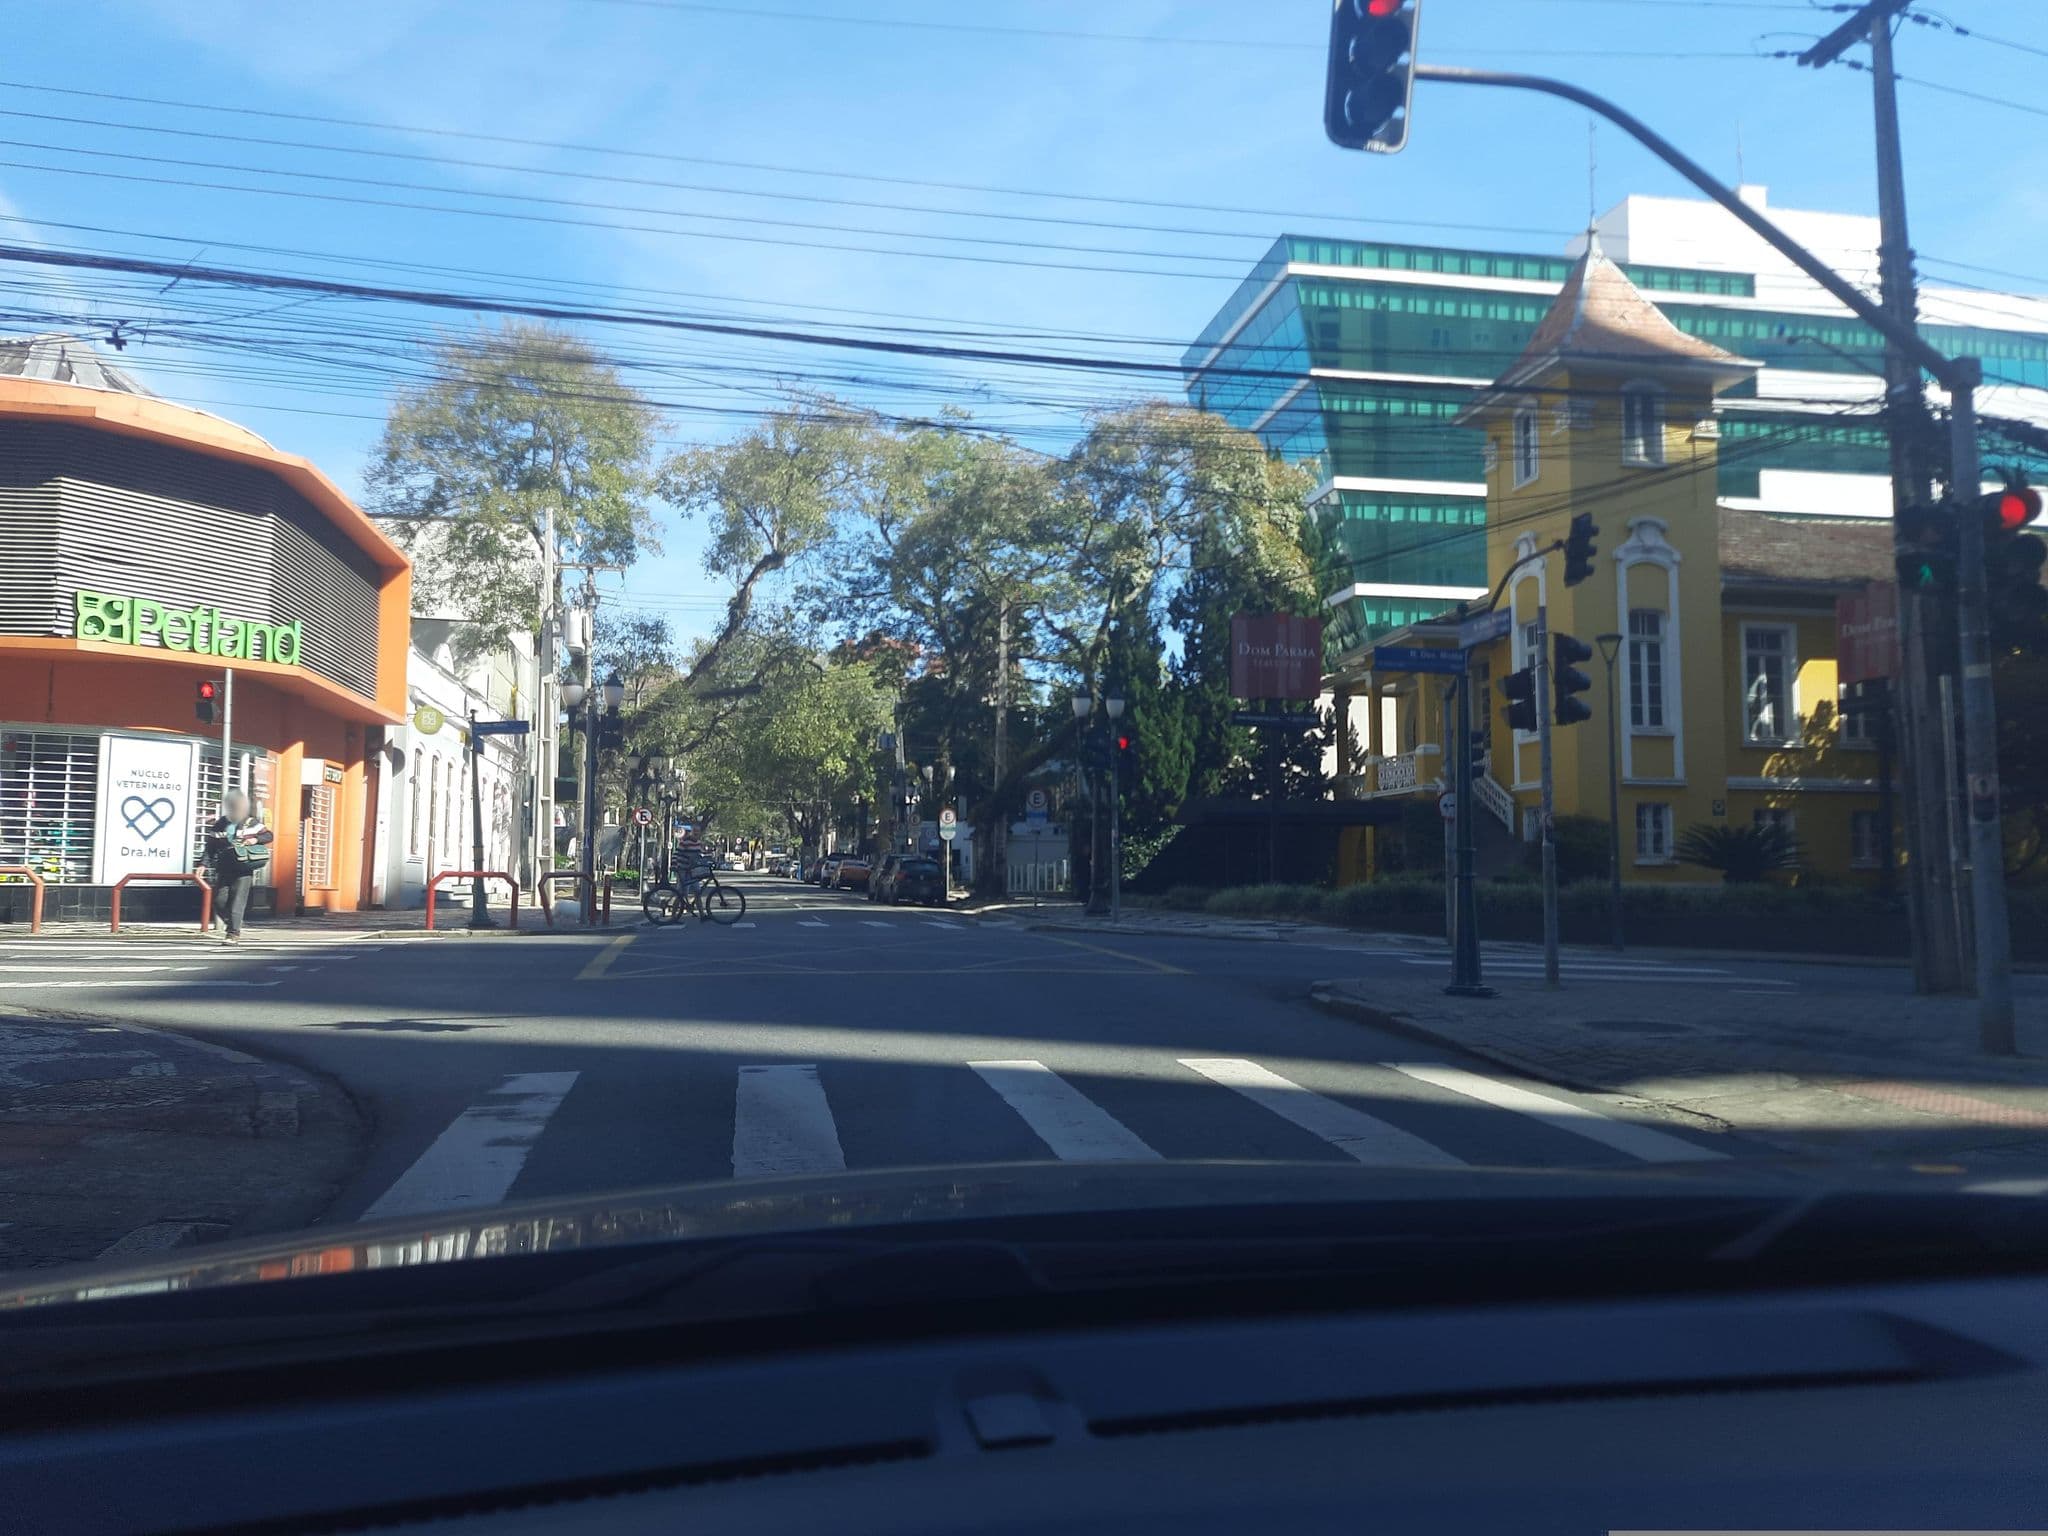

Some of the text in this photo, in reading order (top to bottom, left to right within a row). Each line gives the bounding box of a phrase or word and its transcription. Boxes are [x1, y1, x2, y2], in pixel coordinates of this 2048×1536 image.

[133, 598, 302, 665] Petland
[1033, 793, 1041, 803] E
[944, 812, 951, 821] E
[121, 846, 171, 858] Dra.Mei
